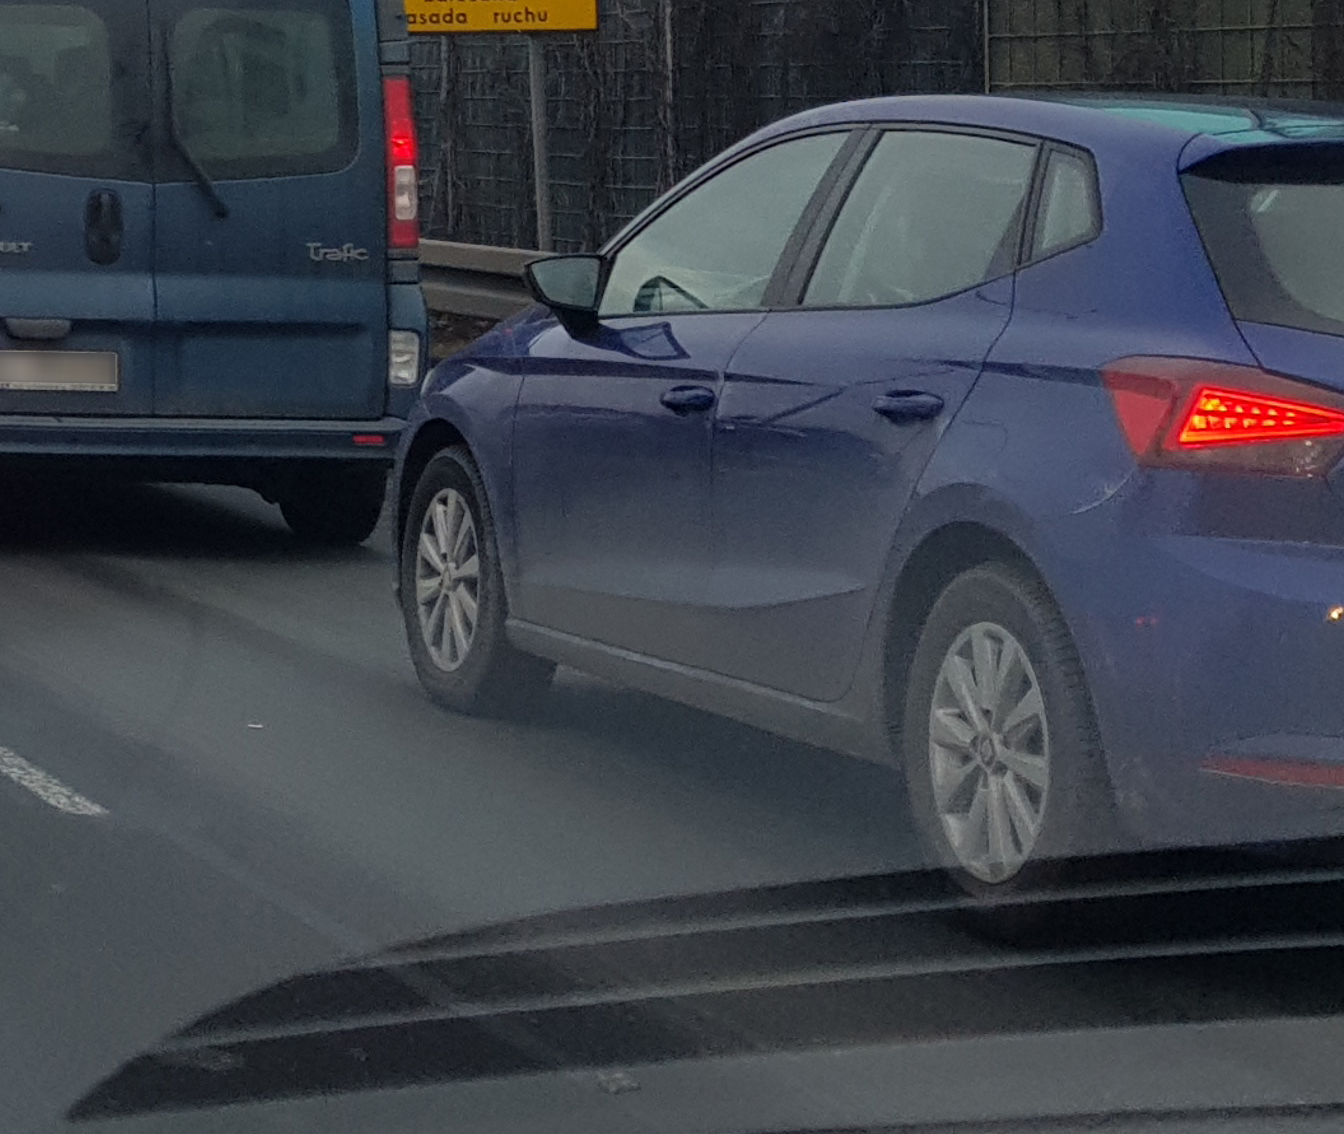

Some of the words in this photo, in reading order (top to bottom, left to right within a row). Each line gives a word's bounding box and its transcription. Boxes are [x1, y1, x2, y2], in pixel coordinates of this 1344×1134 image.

[406, 7, 468, 25] asada
[493, 6, 549, 24] ruchu
[305, 242, 369, 262] Trafic
